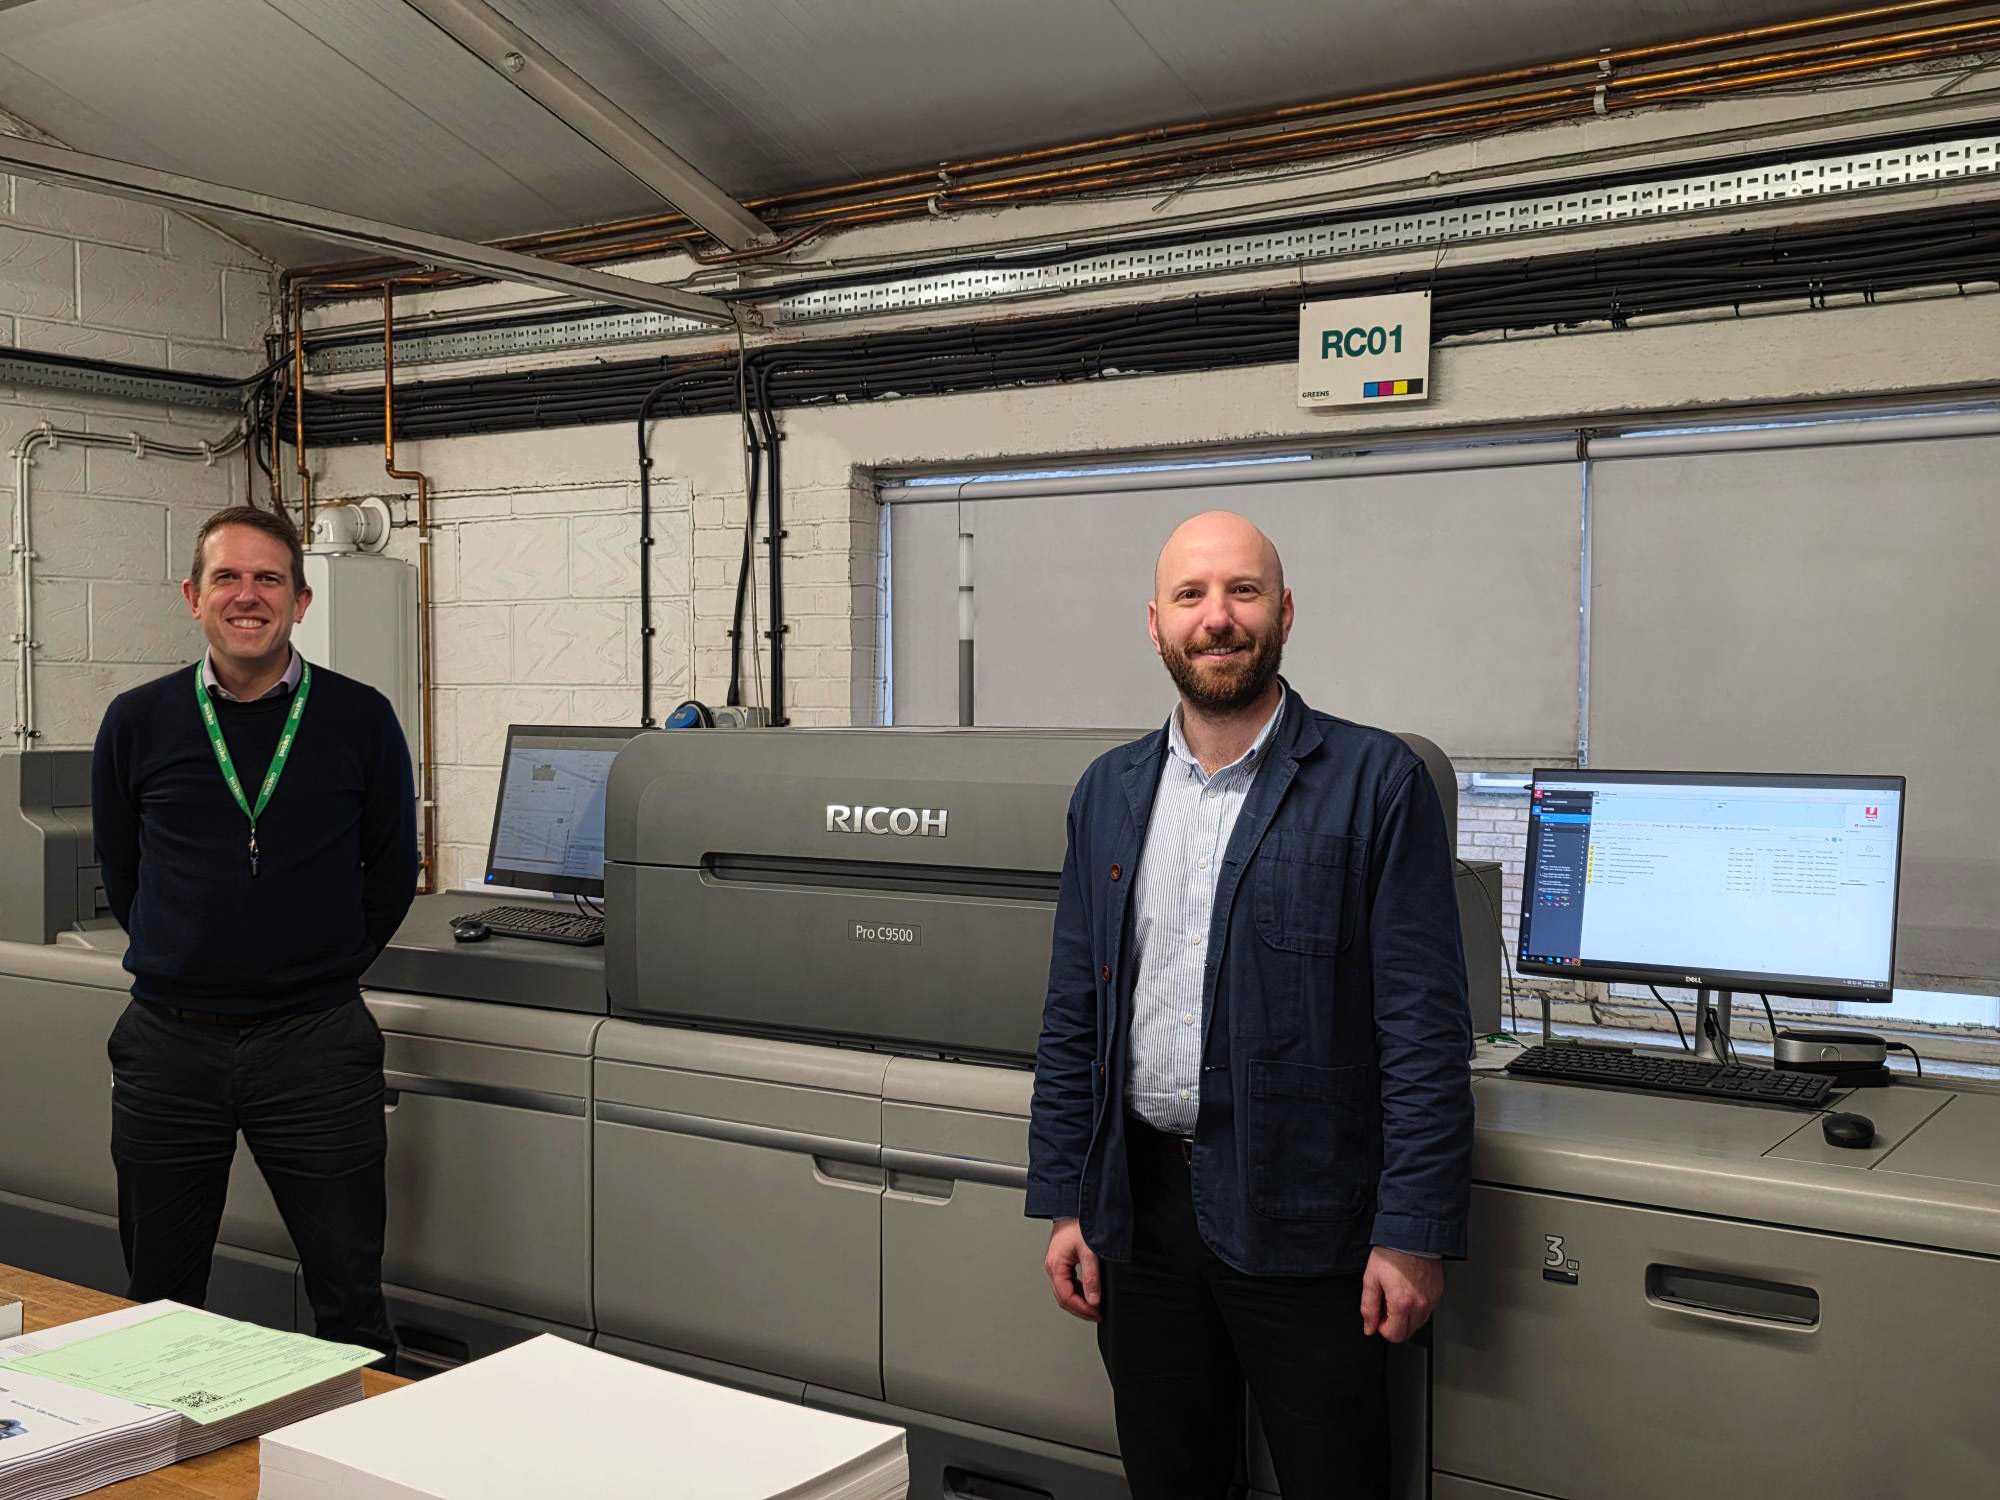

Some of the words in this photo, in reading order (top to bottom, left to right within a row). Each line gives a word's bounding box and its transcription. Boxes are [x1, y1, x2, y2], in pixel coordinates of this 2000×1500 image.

[1321, 324, 1402, 359] RC01
[1302, 390, 1330, 398] GREENS
[826, 805, 948, 837] RICOH
[856, 925, 875, 939] Pro
[877, 927, 913, 942] C9500
[1685, 976, 1703, 984] DELL
[1544, 1234, 1565, 1267] 3
